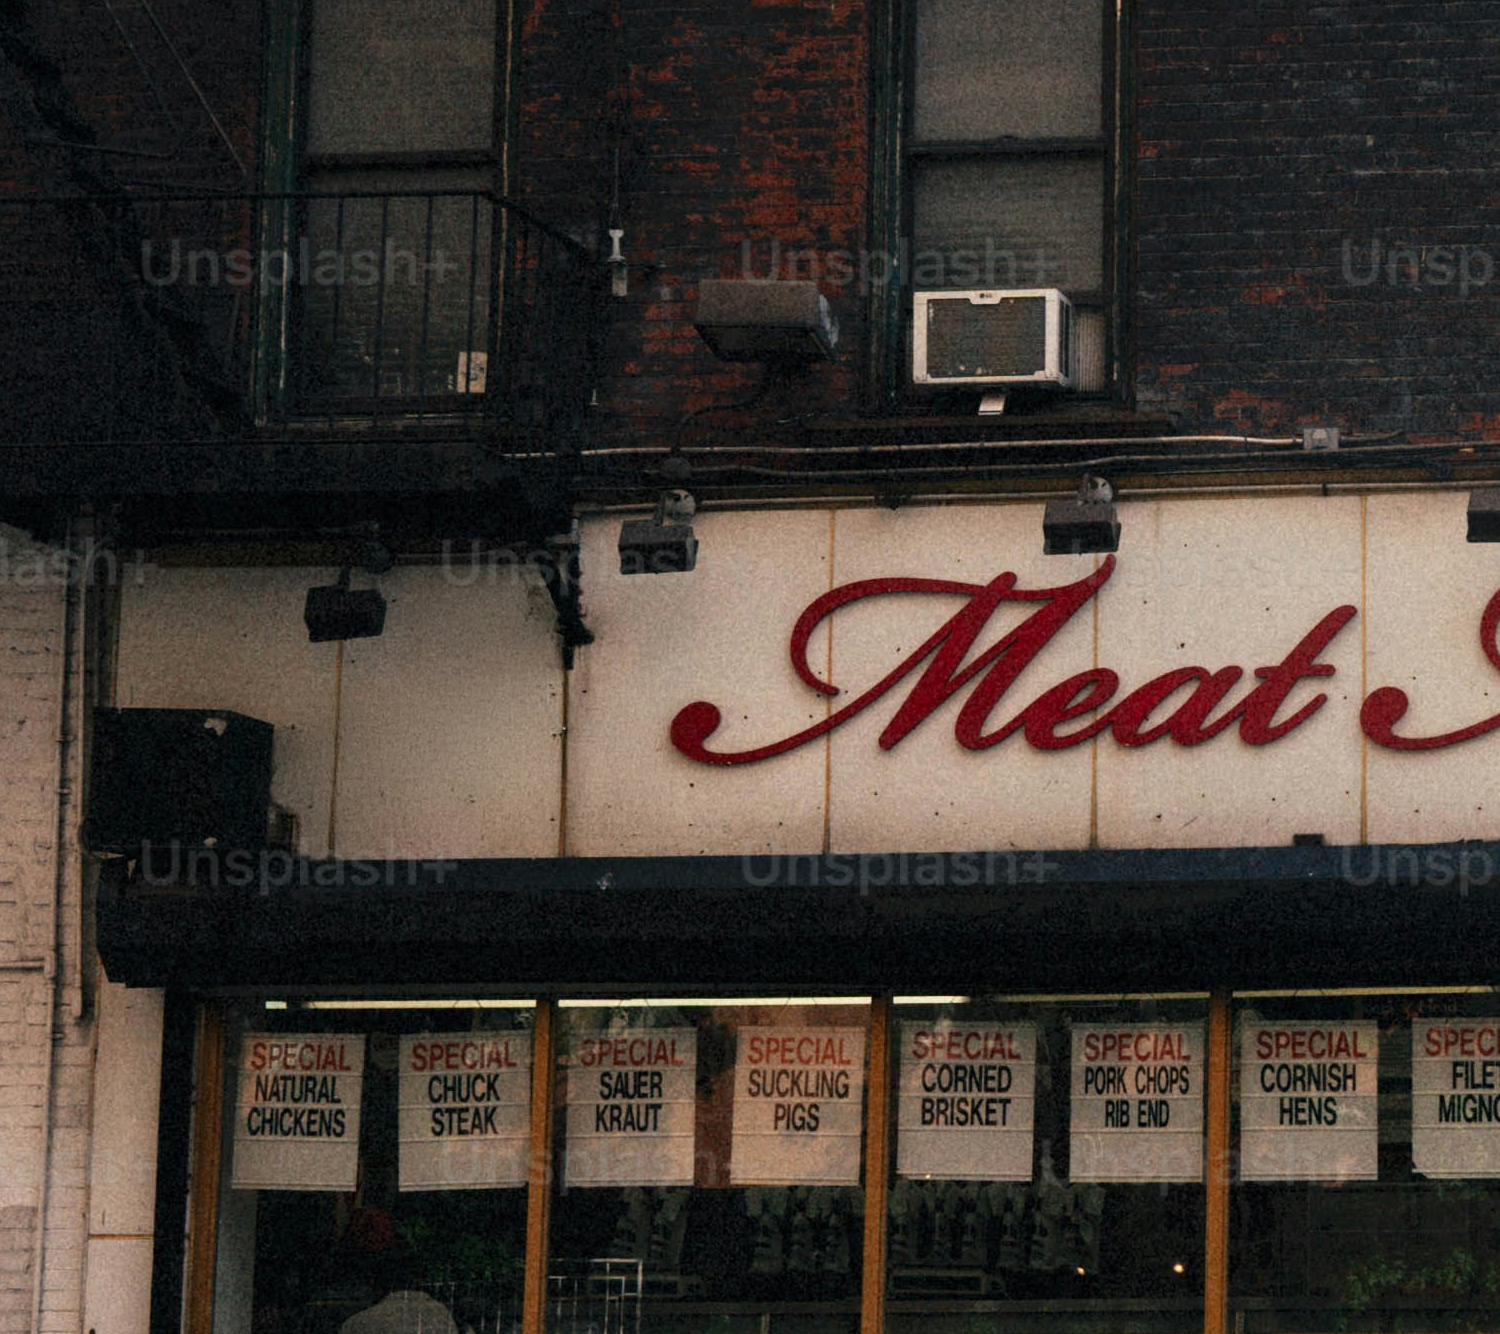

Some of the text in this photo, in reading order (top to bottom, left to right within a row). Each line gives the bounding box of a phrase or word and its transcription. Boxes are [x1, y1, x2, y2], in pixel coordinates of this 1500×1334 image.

[670, 553, 1358, 766] Meat
[250, 1041, 352, 1071] SPECIAL
[411, 1041, 518, 1072] SPECIAL
[580, 1038, 685, 1067] SPECIAL
[747, 1036, 852, 1066] SPECIAL
[911, 1031, 1021, 1061] SPECIAL
[1084, 1032, 1191, 1062] SPECIAL
[1255, 1029, 1367, 1061] SPECIAL
[253, 1074, 341, 1105] NATURAL
[427, 1073, 500, 1104] CHUCK
[600, 1071, 664, 1100] SAUER
[747, 1069, 850, 1100] SUCKLING
[921, 1064, 1013, 1094] CORNED
[1084, 1065, 1190, 1095] PORK CHOPS
[1259, 1063, 1358, 1094] CORNISH
[246, 1106, 346, 1138] CHICKENS
[430, 1106, 498, 1136] STEAK
[594, 1104, 663, 1133] KRAUT
[774, 1103, 821, 1132] PIGS
[920, 1097, 1012, 1127] BRISKET
[1104, 1099, 1171, 1128] RIB END
[1278, 1096, 1338, 1126] HENS
